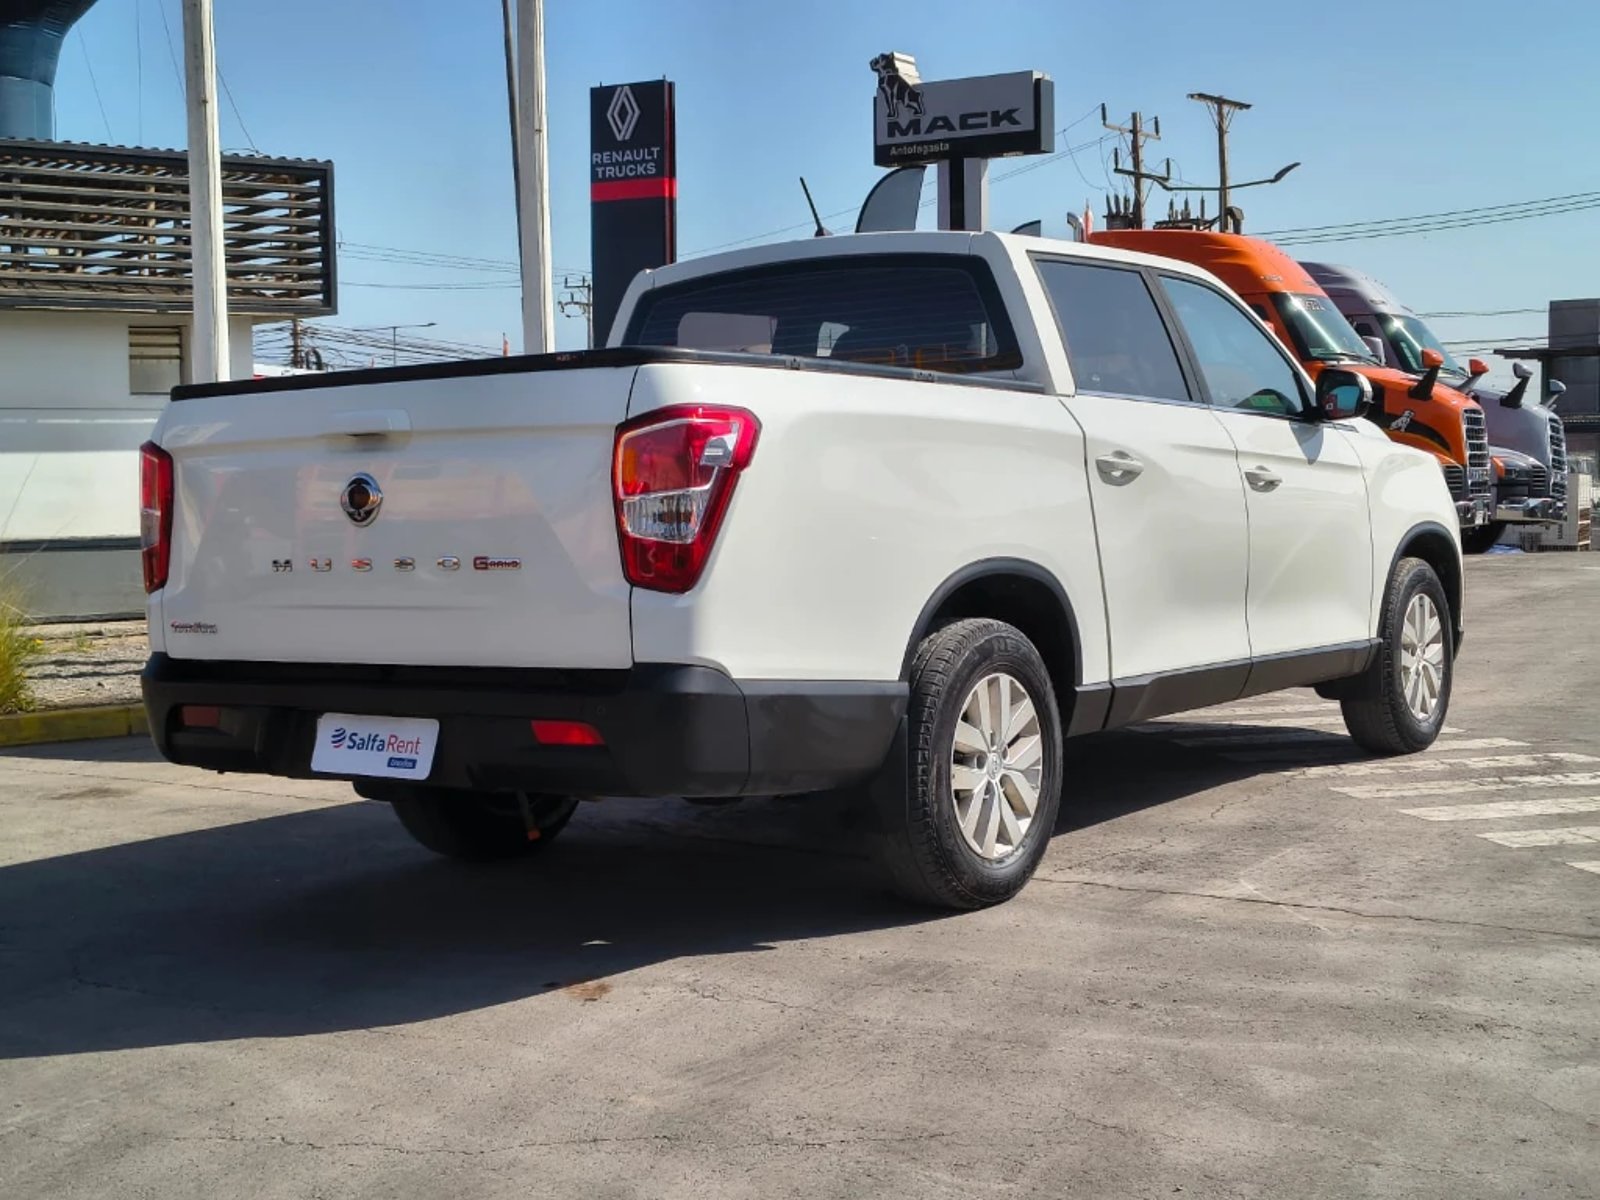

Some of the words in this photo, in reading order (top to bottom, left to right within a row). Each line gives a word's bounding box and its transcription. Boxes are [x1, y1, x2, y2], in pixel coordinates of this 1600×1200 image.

[887, 107, 1022, 138] MACK
[592, 147, 660, 165] RENAULT
[595, 162, 656, 179] TRUCKS
[346, 732, 421, 755] SalfaRent
